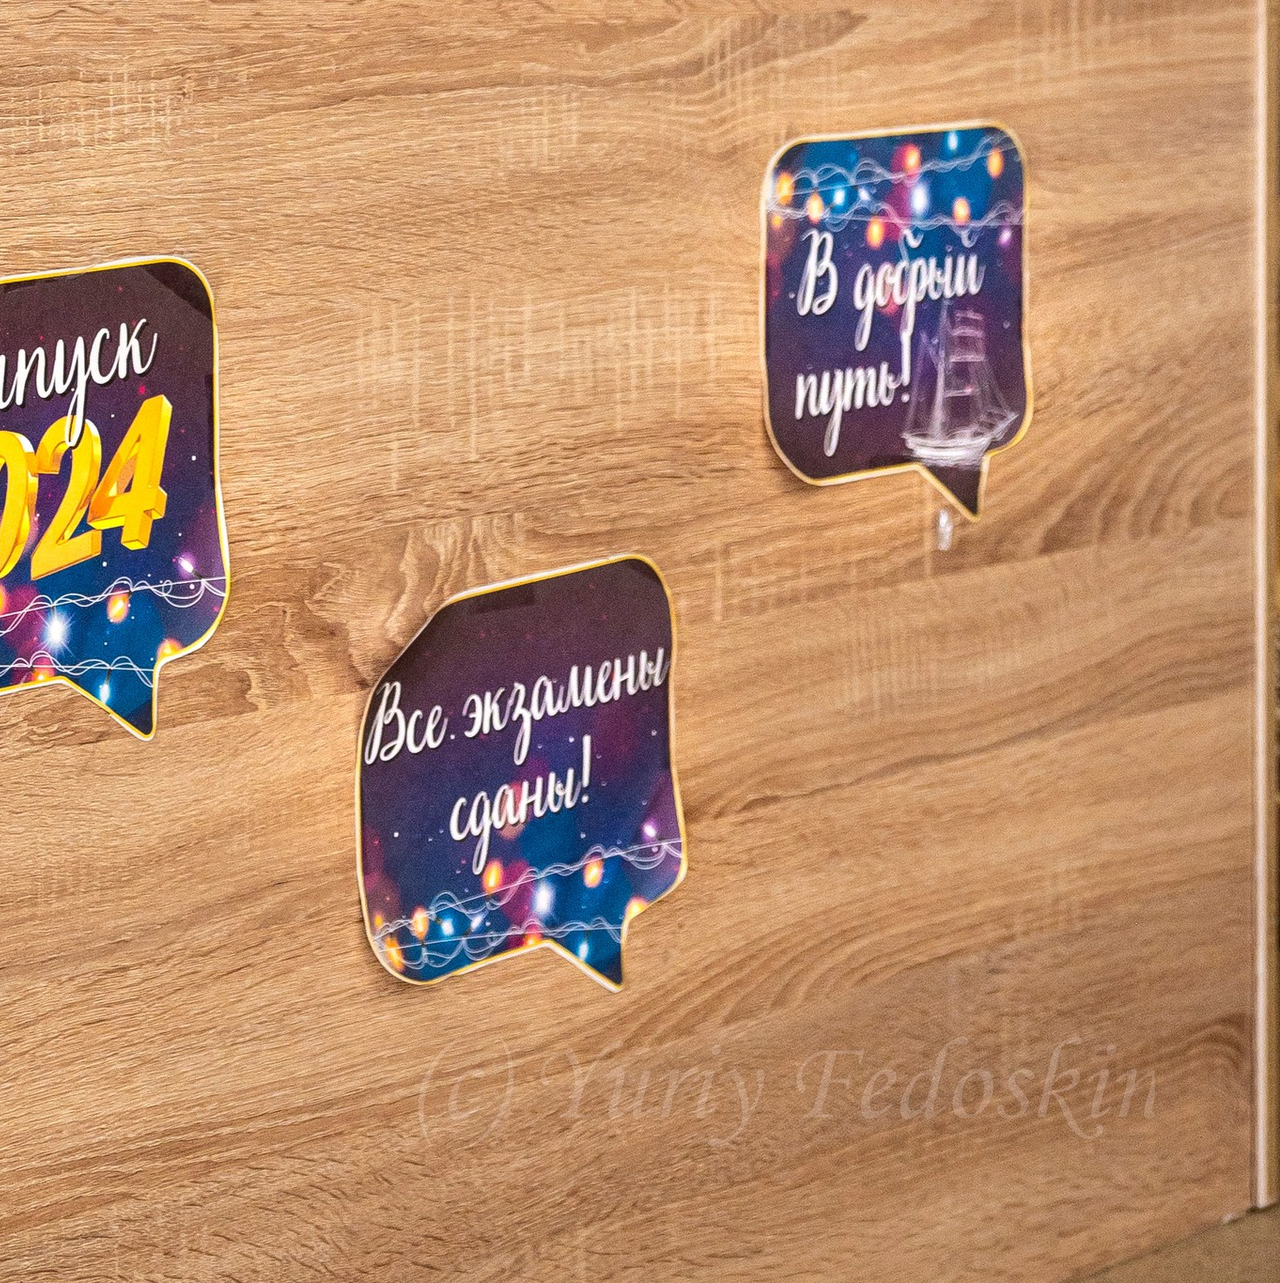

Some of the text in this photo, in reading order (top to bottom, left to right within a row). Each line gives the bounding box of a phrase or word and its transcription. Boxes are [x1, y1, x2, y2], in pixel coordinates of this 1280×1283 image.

[796, 227, 987, 352] В добрый
[794, 327, 912, 458] путь!
[363, 647, 672, 766] Все экзамены
[448, 734, 592, 876] сданы!
